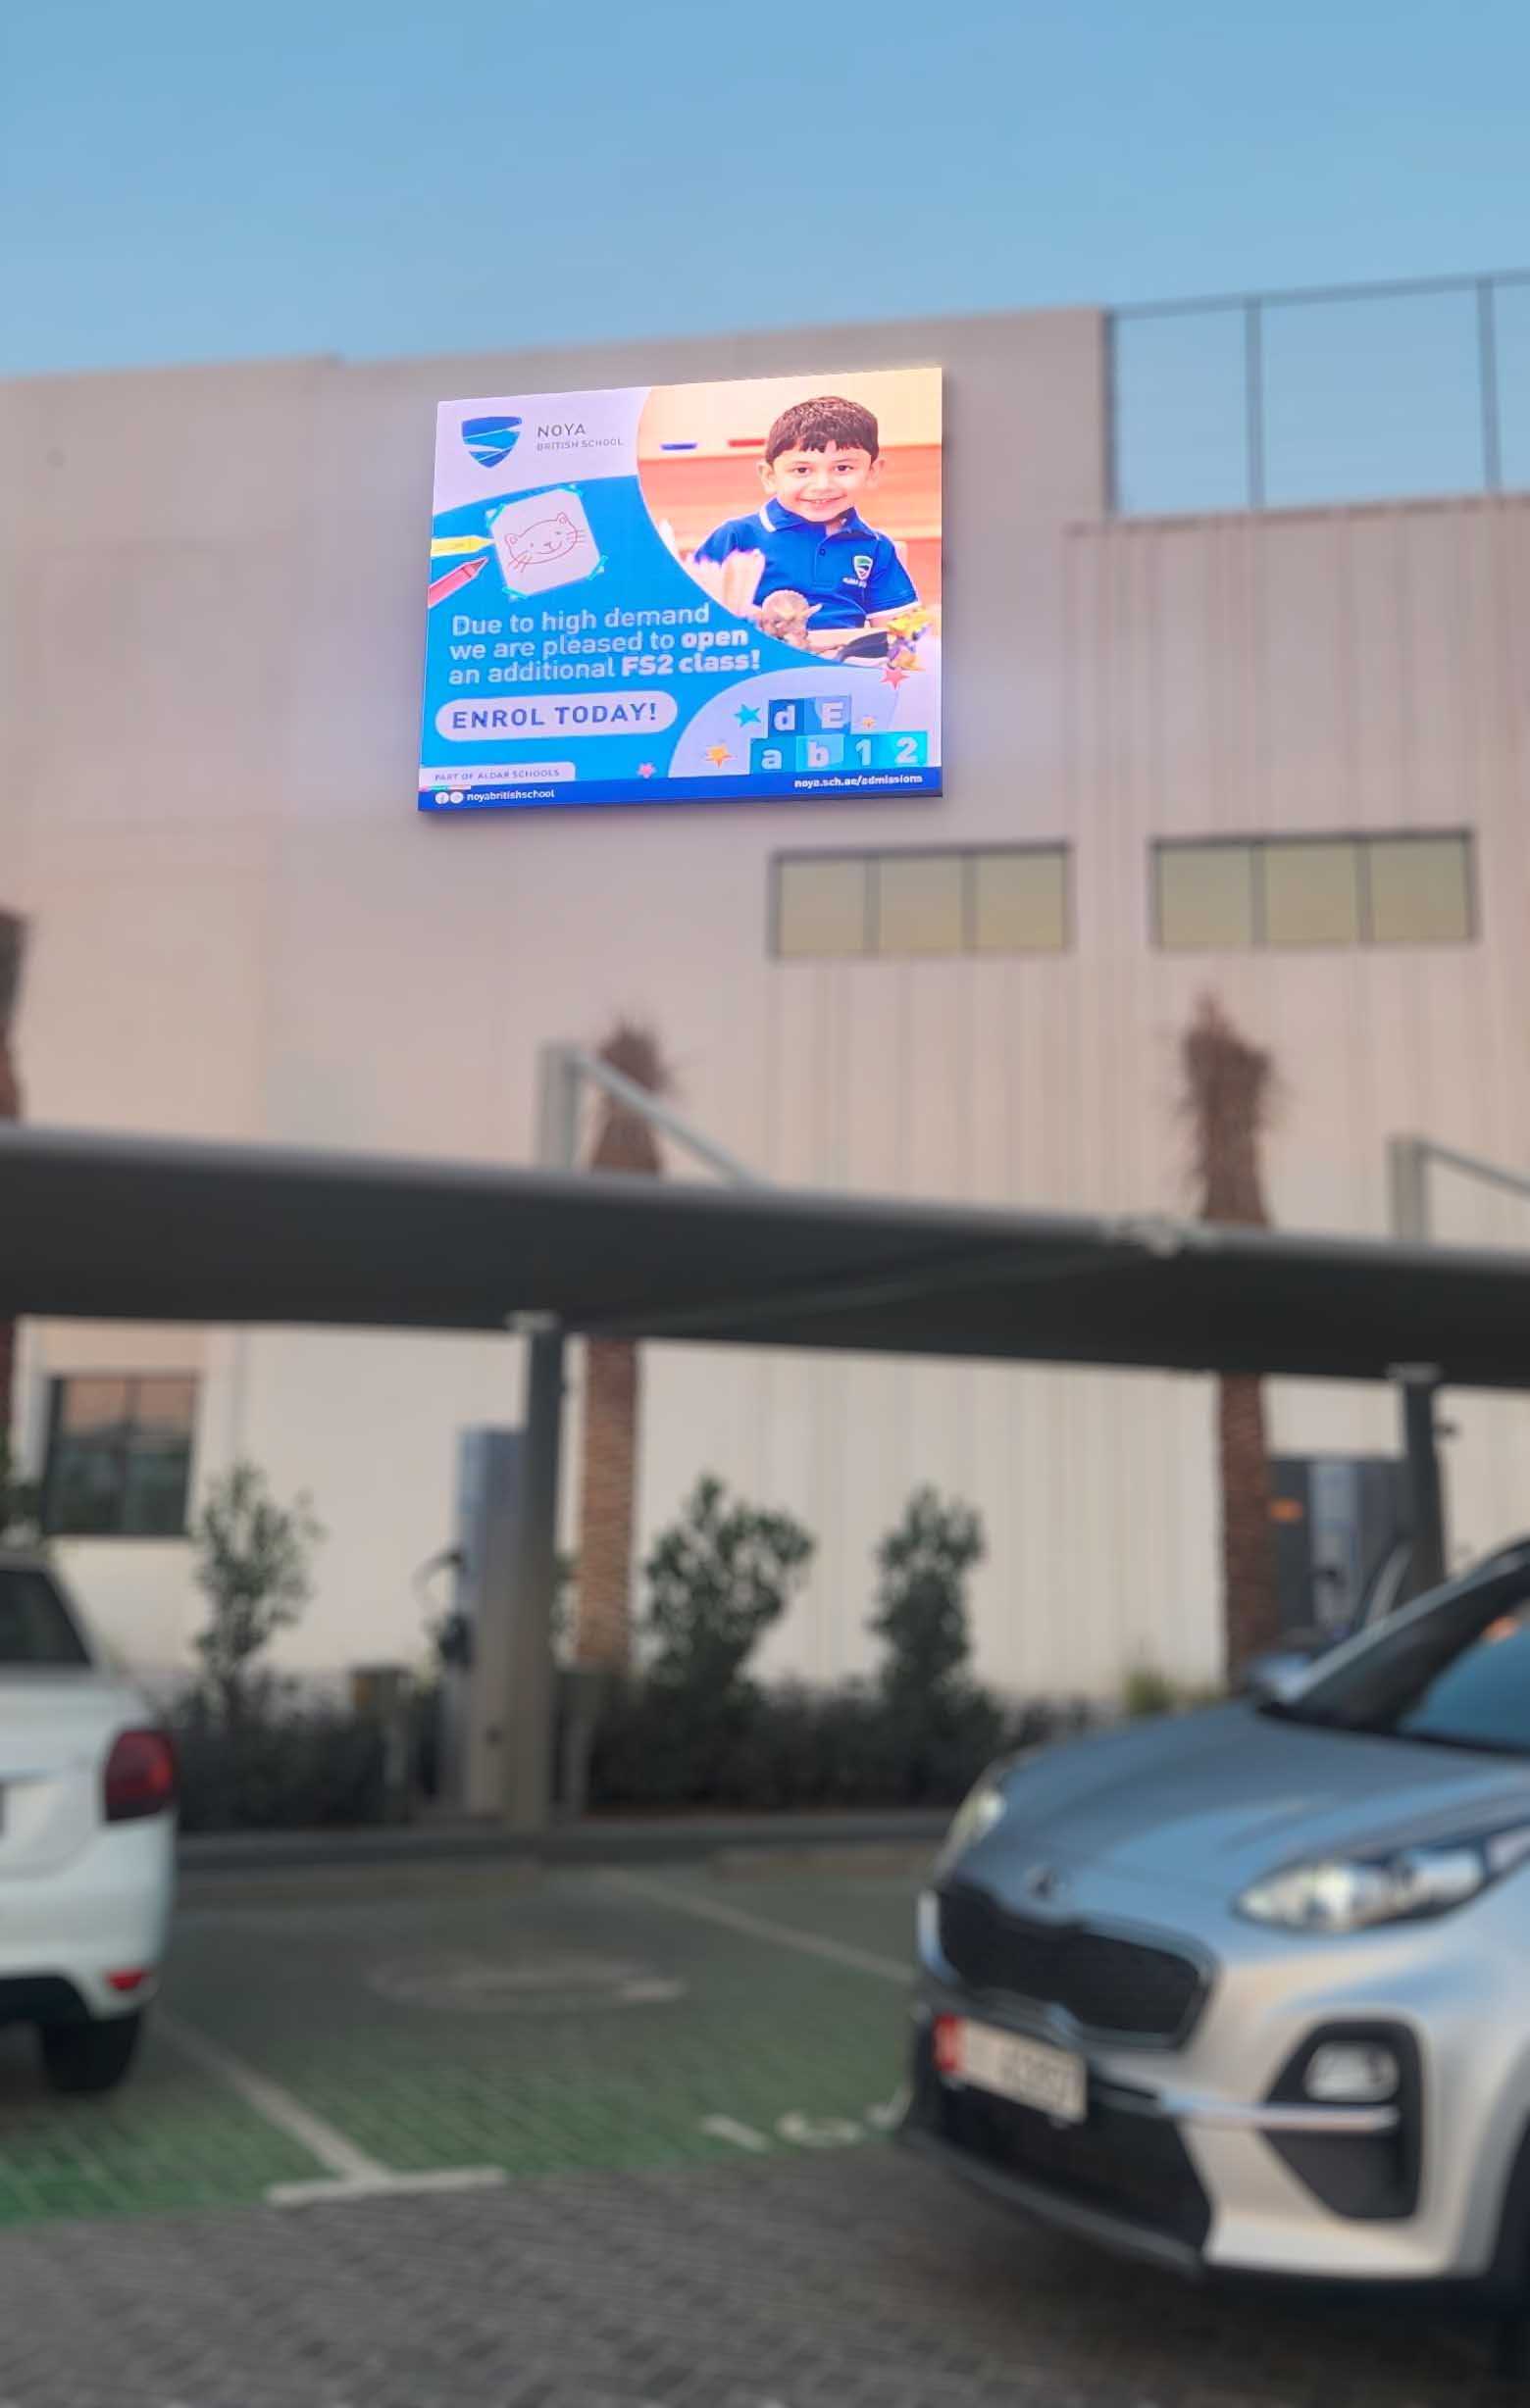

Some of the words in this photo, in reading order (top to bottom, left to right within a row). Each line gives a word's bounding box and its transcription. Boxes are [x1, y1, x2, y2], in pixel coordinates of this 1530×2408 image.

[537, 423, 586, 437] NOYA
[537, 440, 579, 451] BRITISH
[582, 438, 624, 448] SCHOOL
[451, 615, 502, 636] Due
[509, 614, 534, 632] to
[541, 610, 597, 635] high
[604, 603, 710, 628] demand
[449, 644, 486, 660] we
[493, 640, 536, 658] are
[542, 634, 642, 660] pleased
[649, 632, 675, 651] to
[681, 629, 748, 651] open
[448, 668, 480, 684] an
[487, 657, 615, 682] additional
[621, 655, 674, 677] FS2
[678, 649, 761, 674] class!
[452, 709, 544, 729] ENROL
[554, 702, 657, 726] TODAY!
[773, 705, 796, 731] d
[820, 702, 845, 729] E
[761, 748, 783, 770] a
[807, 742, 831, 769] b
[855, 739, 872, 766] 1
[895, 736, 918, 764] 2
[513, 769, 560, 778] SCHOOLS
[794, 775, 924, 790] noya.sch.ae/admissions
[466, 789, 555, 803] noyabritishschool
